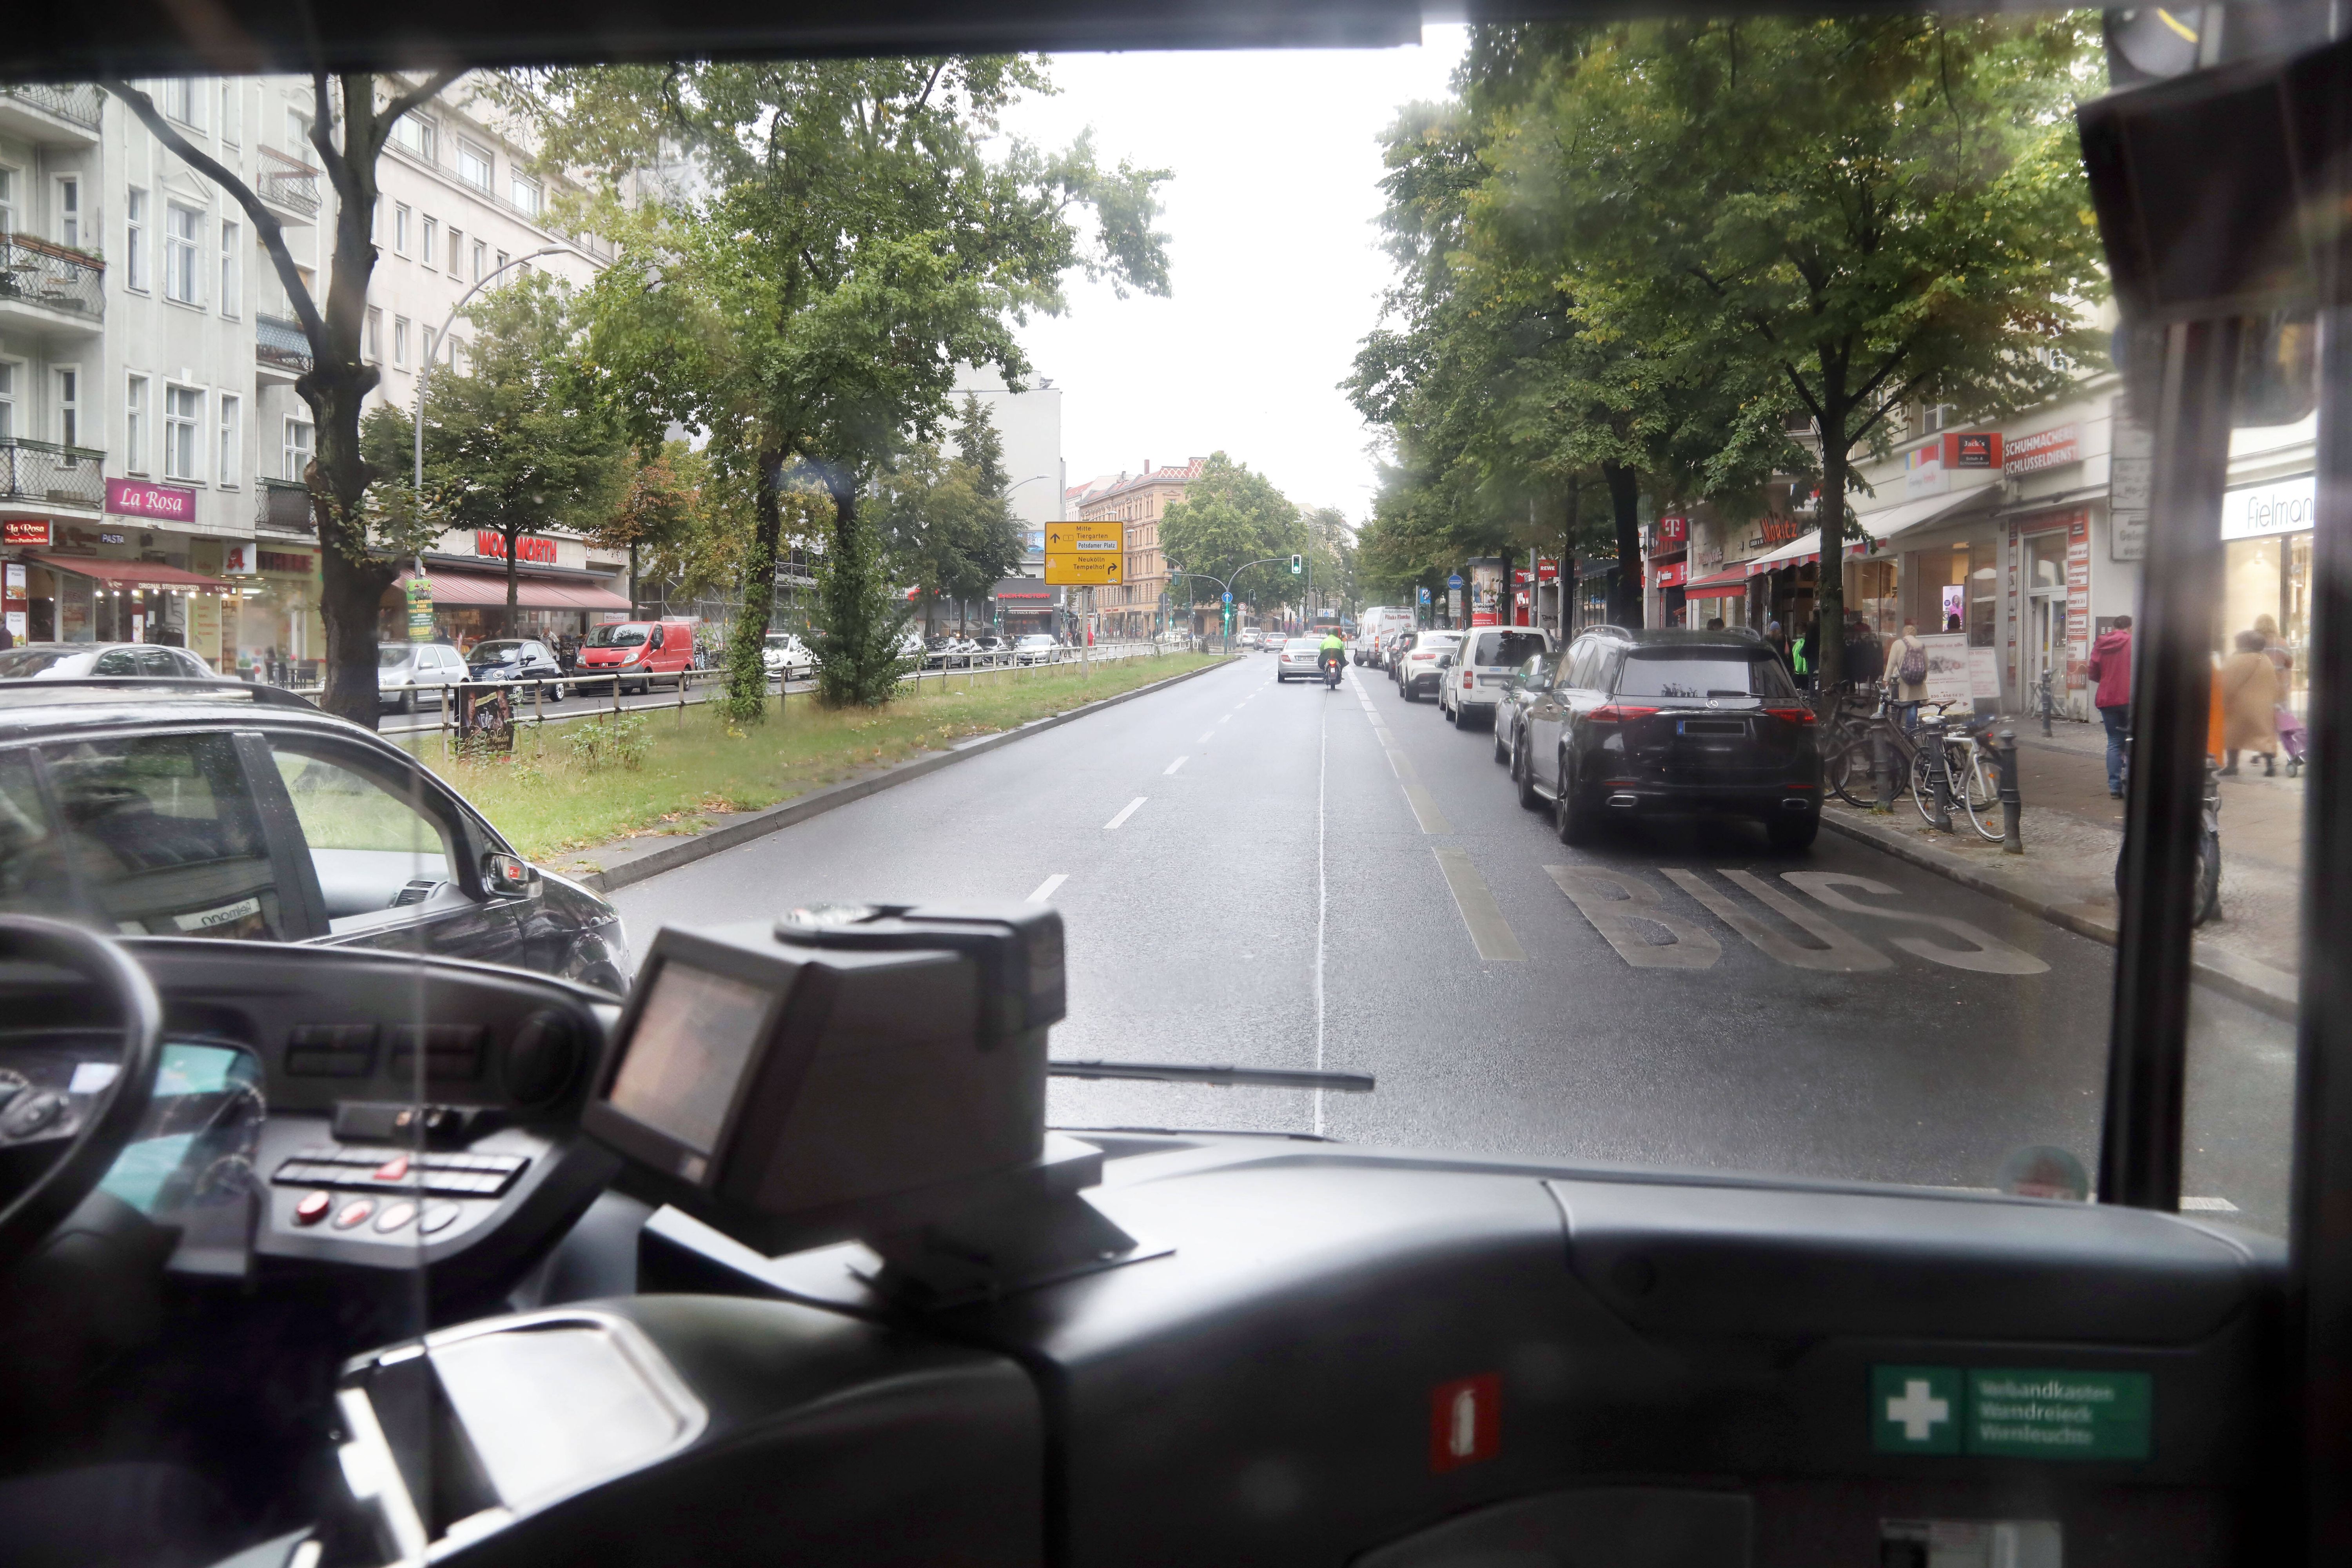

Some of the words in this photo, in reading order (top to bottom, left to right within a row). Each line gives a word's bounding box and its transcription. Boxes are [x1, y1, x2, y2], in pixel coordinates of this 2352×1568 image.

[119, 488, 141, 506] La
[145, 491, 183, 511] Rosa
[6, 524, 20, 536] La
[20, 524, 44, 536] Rosa
[102, 534, 124, 544] PASTA
[477, 530, 557, 563] WOOWORTH
[1542, 865, 2051, 974] BUS
[1980, 1379, 2114, 1402] Verbandkasten
